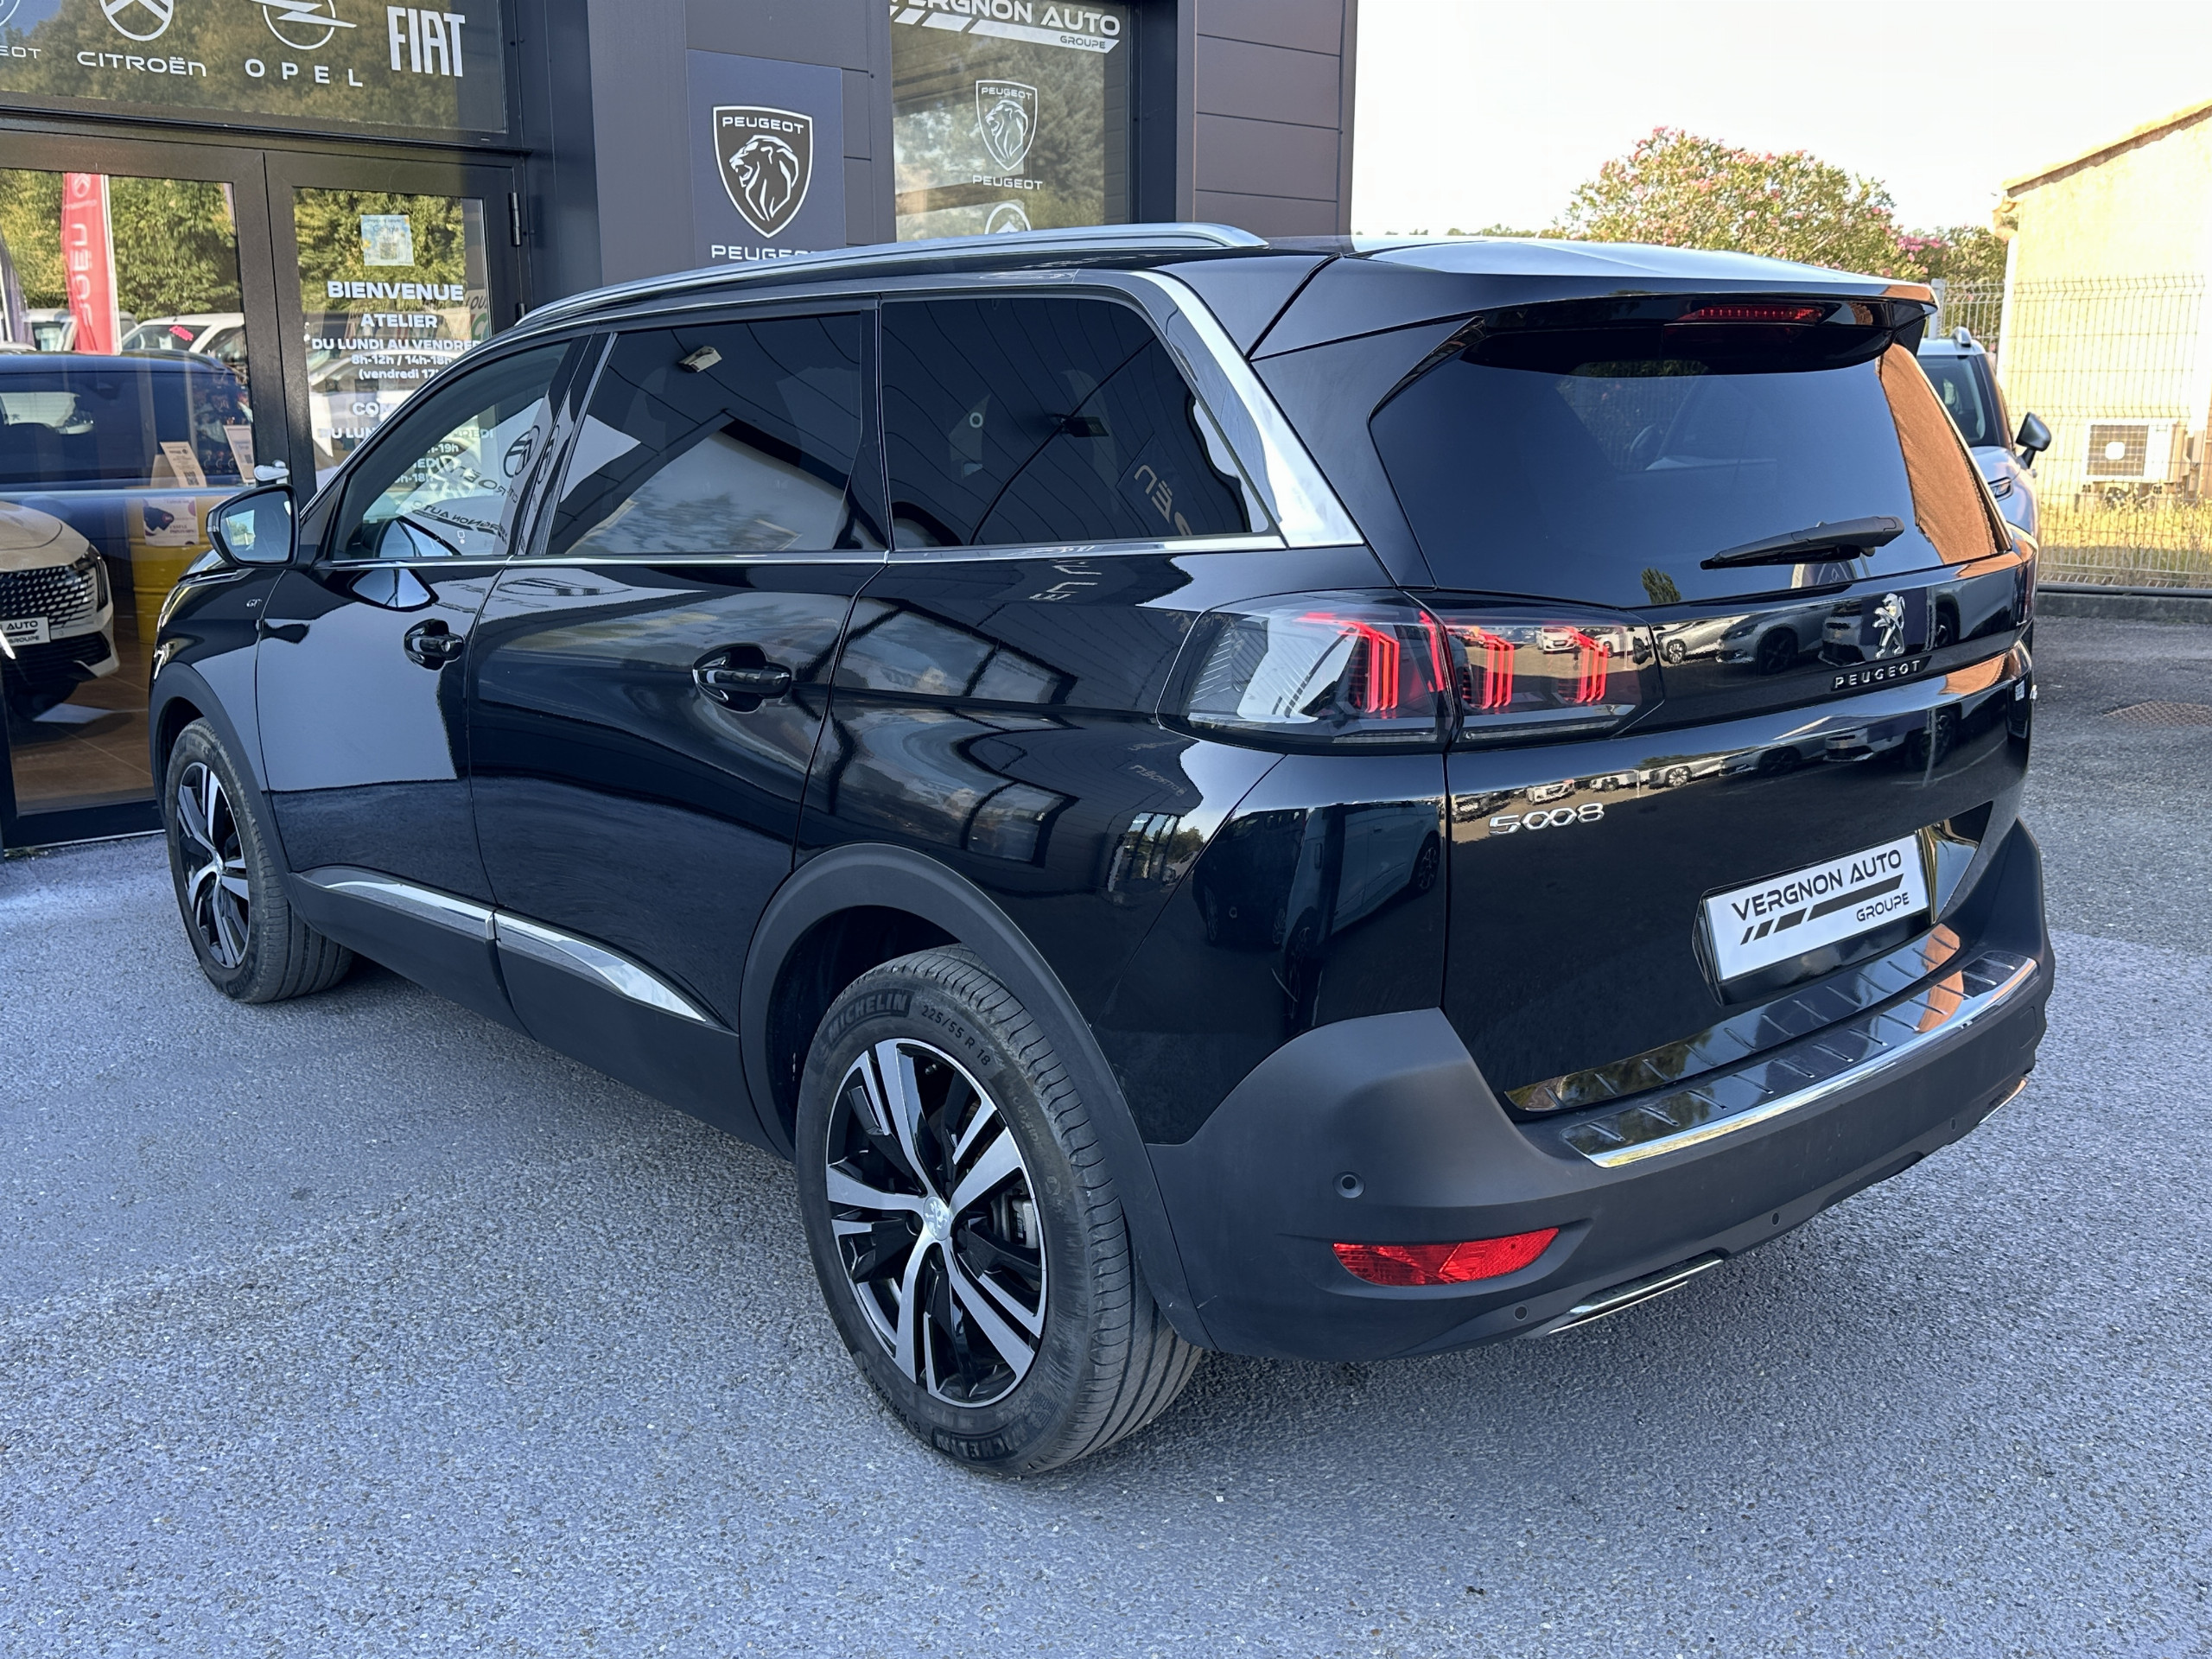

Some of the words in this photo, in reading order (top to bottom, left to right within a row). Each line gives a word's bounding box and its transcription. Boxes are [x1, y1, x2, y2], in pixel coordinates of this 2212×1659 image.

[890, 0, 1033, 23] RGNON
[1040, 6, 1120, 36] AUTO
[386, 5, 466, 78] FIAT
[1059, 35, 1106, 49] GROUPE
[76, 51, 207, 77] CITROËN
[245, 58, 363, 87] OPEL
[981, 86, 1032, 100] PEUGEOT
[722, 117, 804, 134] PEUGEOT
[972, 175, 1043, 190] PEUGEOT
[711, 245, 817, 260] PEUGE
[327, 280, 464, 301] BIENVENUE
[360, 313, 438, 327] ATELIER
[312, 338, 334, 350] DU
[338, 338, 384, 350] LUNDI
[387, 340, 409, 351] AU
[412, 340, 481, 351] VENDRE
[351, 354, 394, 365] 8h-12h
[404, 355, 452, 365] 14h-18h
[359, 368, 419, 379] (vendredi
[346, 427, 377, 439] LUN
[7, 620, 38, 631] AUTO
[1834, 660, 1921, 689] PEUGEOT
[1489, 802, 1605, 836] 5008
[1731, 868, 1843, 921] VERGNON
[1850, 849, 1902, 885] AUTO
[1856, 892, 1910, 922] GROUPE
[828, 993, 907, 1043] MICHELIN
[921, 1005, 965, 1039] 225/55
[964, 1038, 976, 1050] R
[976, 1049, 991, 1066] 18
